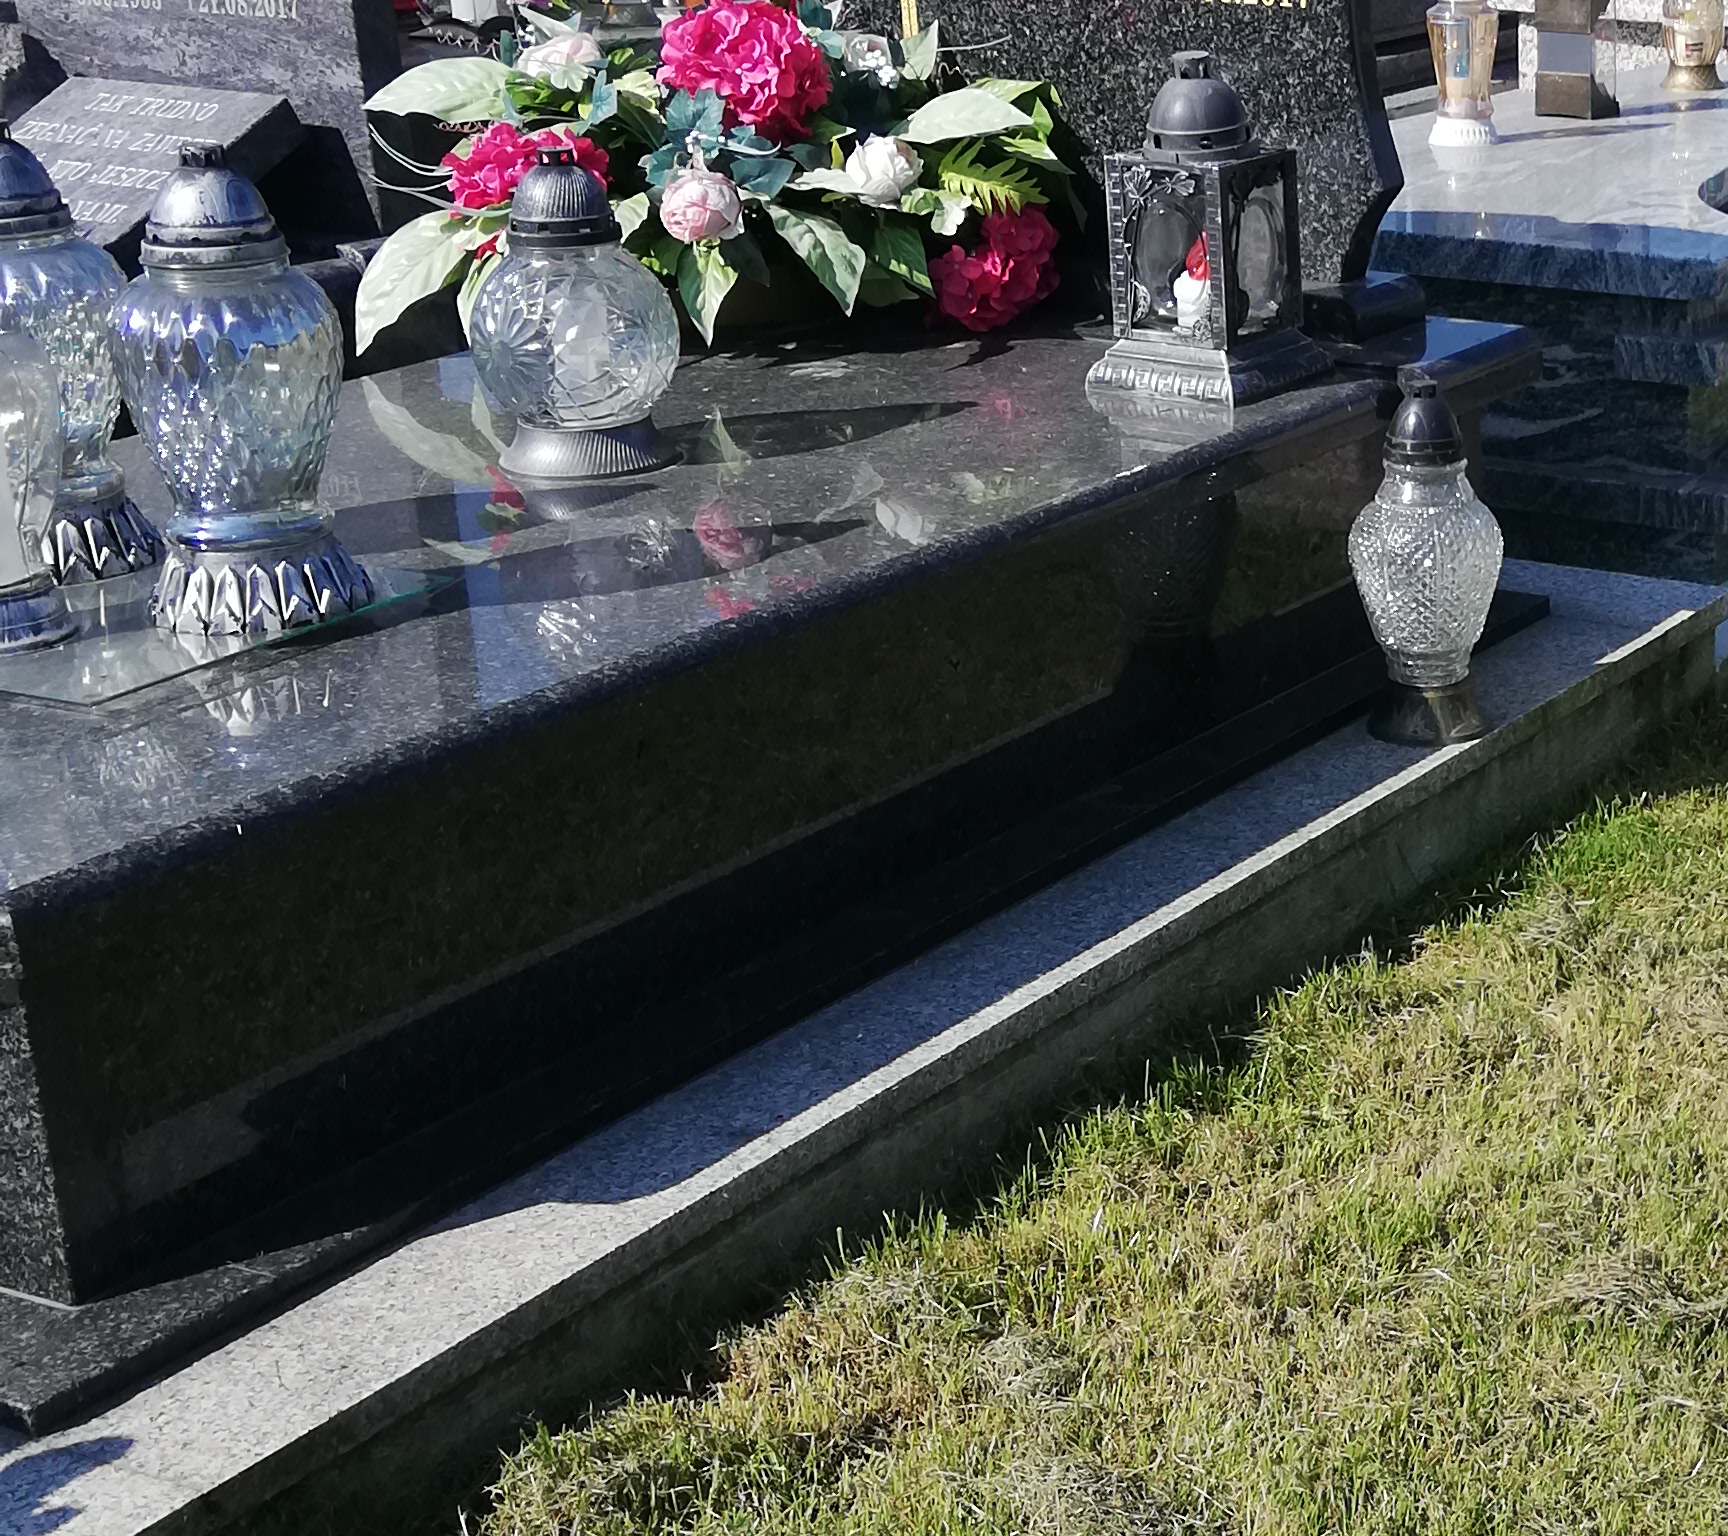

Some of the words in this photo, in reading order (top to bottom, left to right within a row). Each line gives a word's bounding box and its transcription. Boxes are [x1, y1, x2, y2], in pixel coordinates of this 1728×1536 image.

[84, 93, 134, 112] TAK
[131, 97, 219, 121] TRUDNO
[88, 165, 172, 191] JESZCZ
